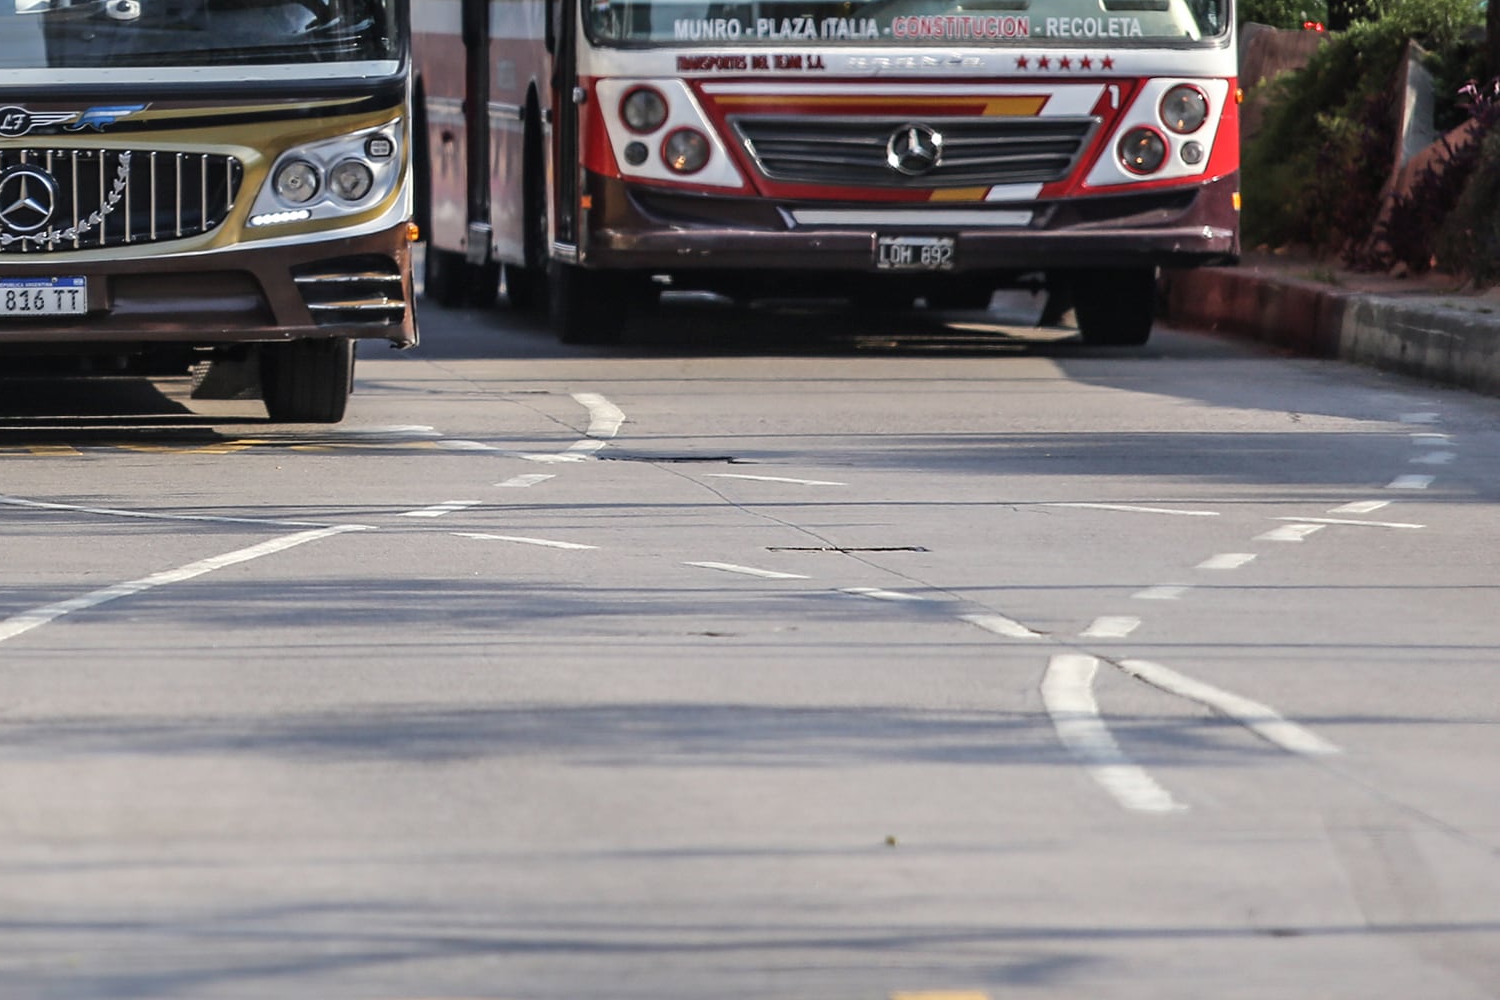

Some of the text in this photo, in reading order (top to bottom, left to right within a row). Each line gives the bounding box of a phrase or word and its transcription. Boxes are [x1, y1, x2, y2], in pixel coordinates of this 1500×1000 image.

[674, 18, 741, 40] MUNRO
[757, 17, 817, 39] PLAZA
[821, 17, 879, 39] ITALIA
[892, 15, 1030, 39] CONSTITUCION
[1046, 16, 1143, 37] RECOLETA
[921, 246, 952, 265] 892
[5, 289, 45, 312] 816
[53, 289, 79, 311] TT
